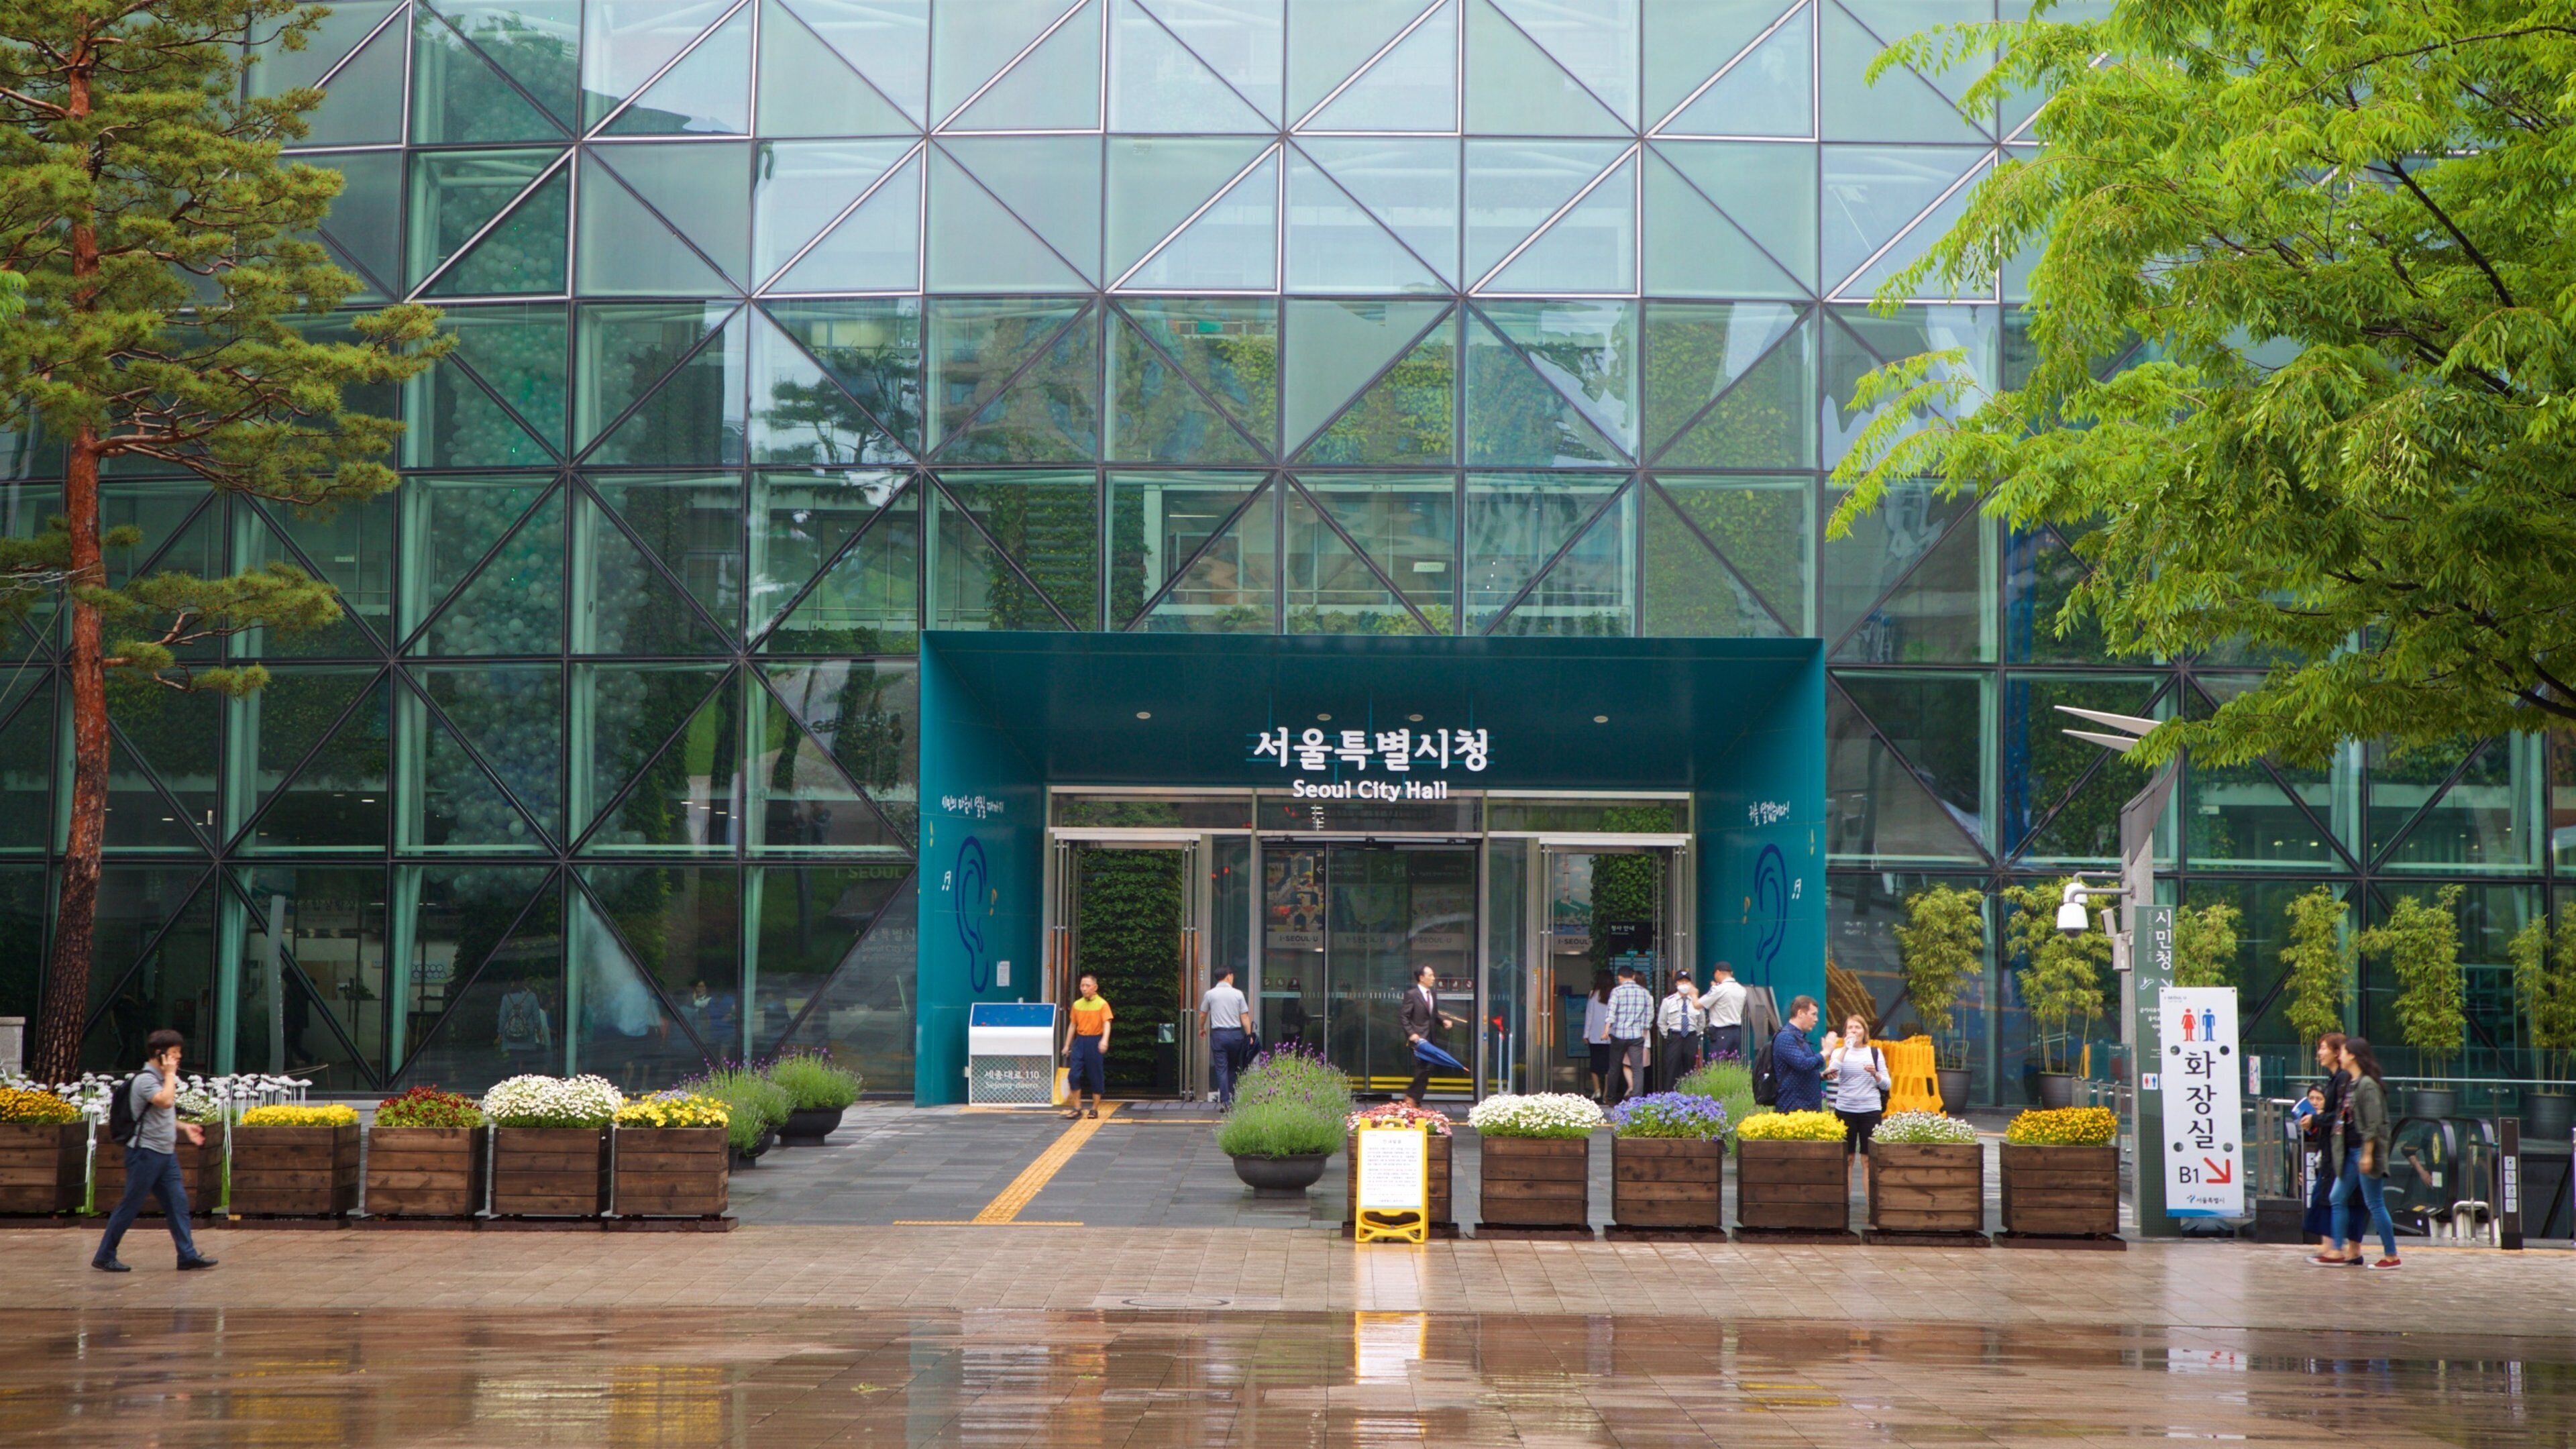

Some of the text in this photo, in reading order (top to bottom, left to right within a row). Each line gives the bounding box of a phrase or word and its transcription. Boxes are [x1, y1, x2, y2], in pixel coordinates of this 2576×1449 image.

[1253, 727, 1488, 771] 서울특별시청
[1293, 780, 1447, 802] Seoul City Hall
[2155, 909, 2172, 971] 시민청
[984, 1070, 1040, 1080] 세종대로 110
[2184, 1051, 2217, 1149] 화장실
[2179, 1167, 2199, 1184] B1
